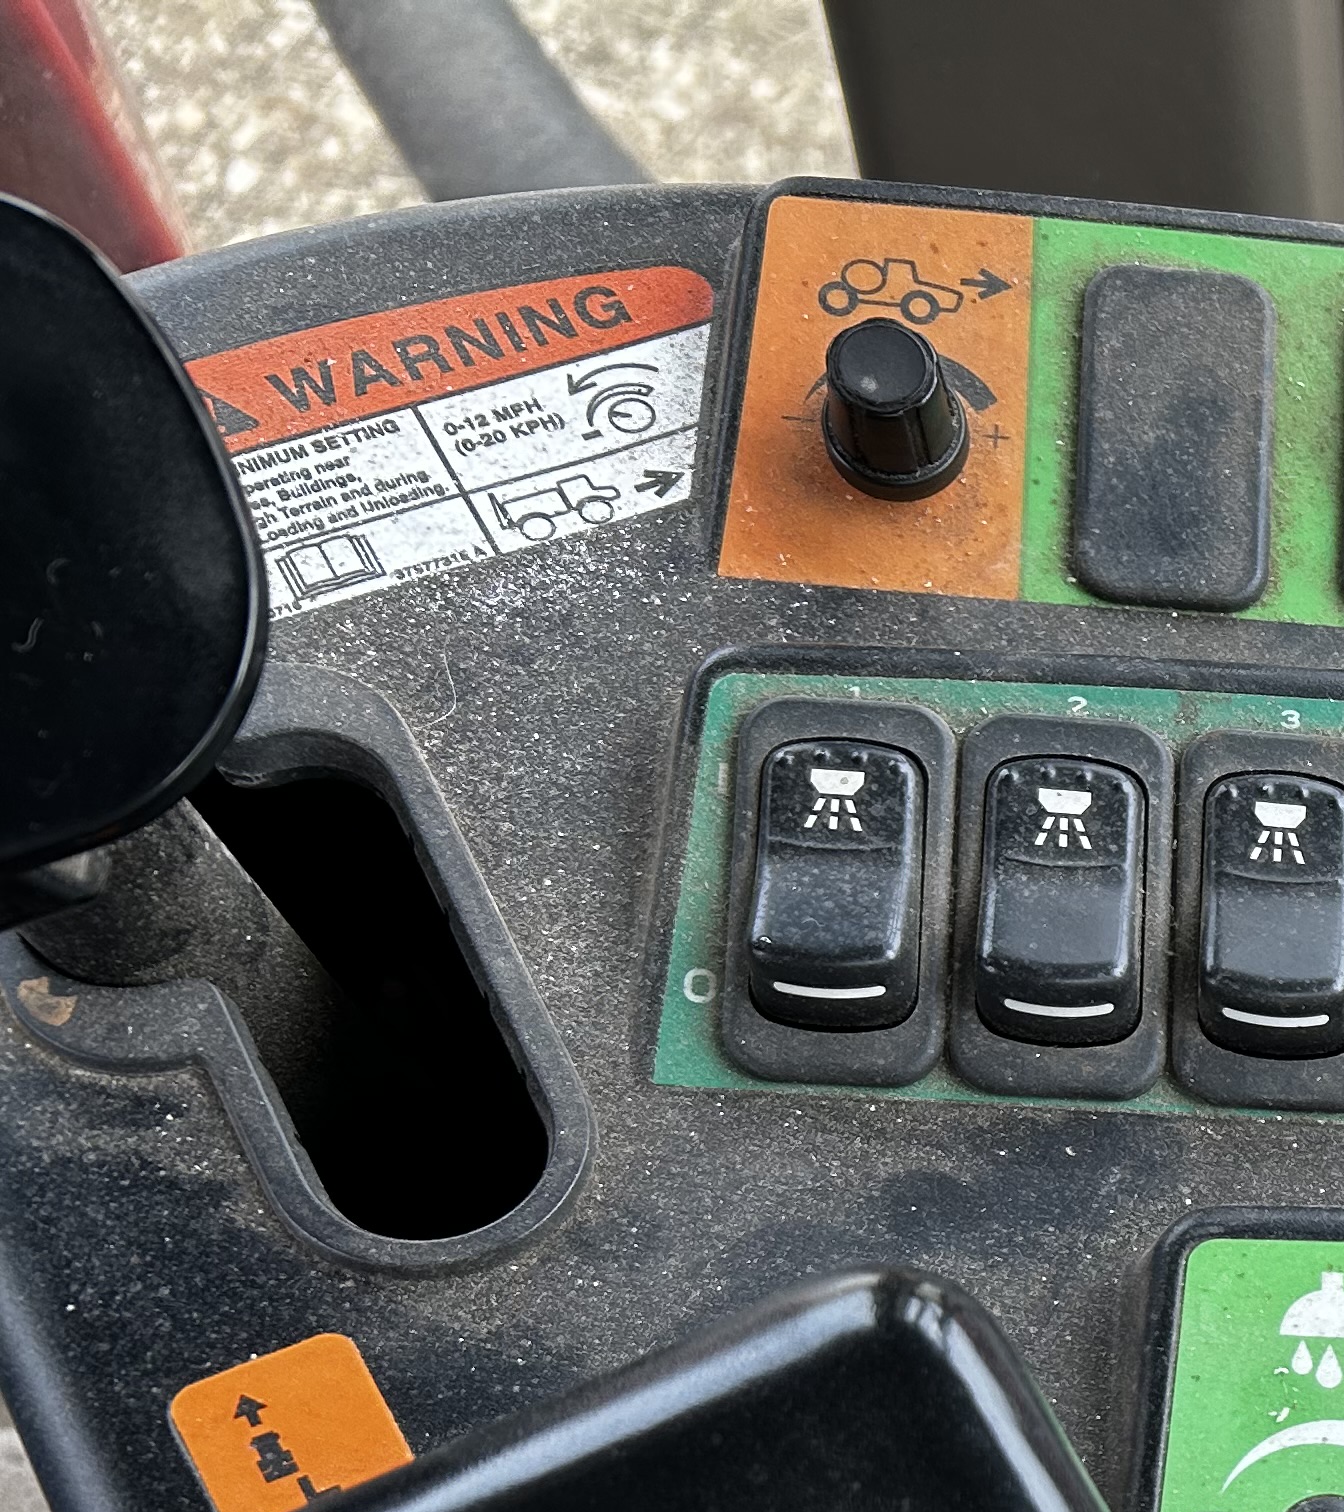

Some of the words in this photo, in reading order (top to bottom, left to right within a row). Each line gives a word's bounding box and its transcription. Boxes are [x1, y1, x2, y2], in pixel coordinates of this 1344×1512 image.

[264, 286, 632, 413] WARNING
[443, 412, 491, 436] 0-12
[490, 397, 545, 423] MPH
[454, 428, 508, 457] (0-20
[508, 411, 566, 439] KPH)
[236, 443, 310, 475] NIMUM
[310, 418, 401, 454] SETTING
[241, 466, 313, 498] perating
[313, 455, 351, 475] near
[276, 473, 363, 502] Buildings,
[277, 494, 339, 519] Terrain
[340, 482, 373, 503] and
[327, 504, 360, 524] and
[1066, 696, 1089, 713] 2
[1280, 709, 1300, 729] 3
